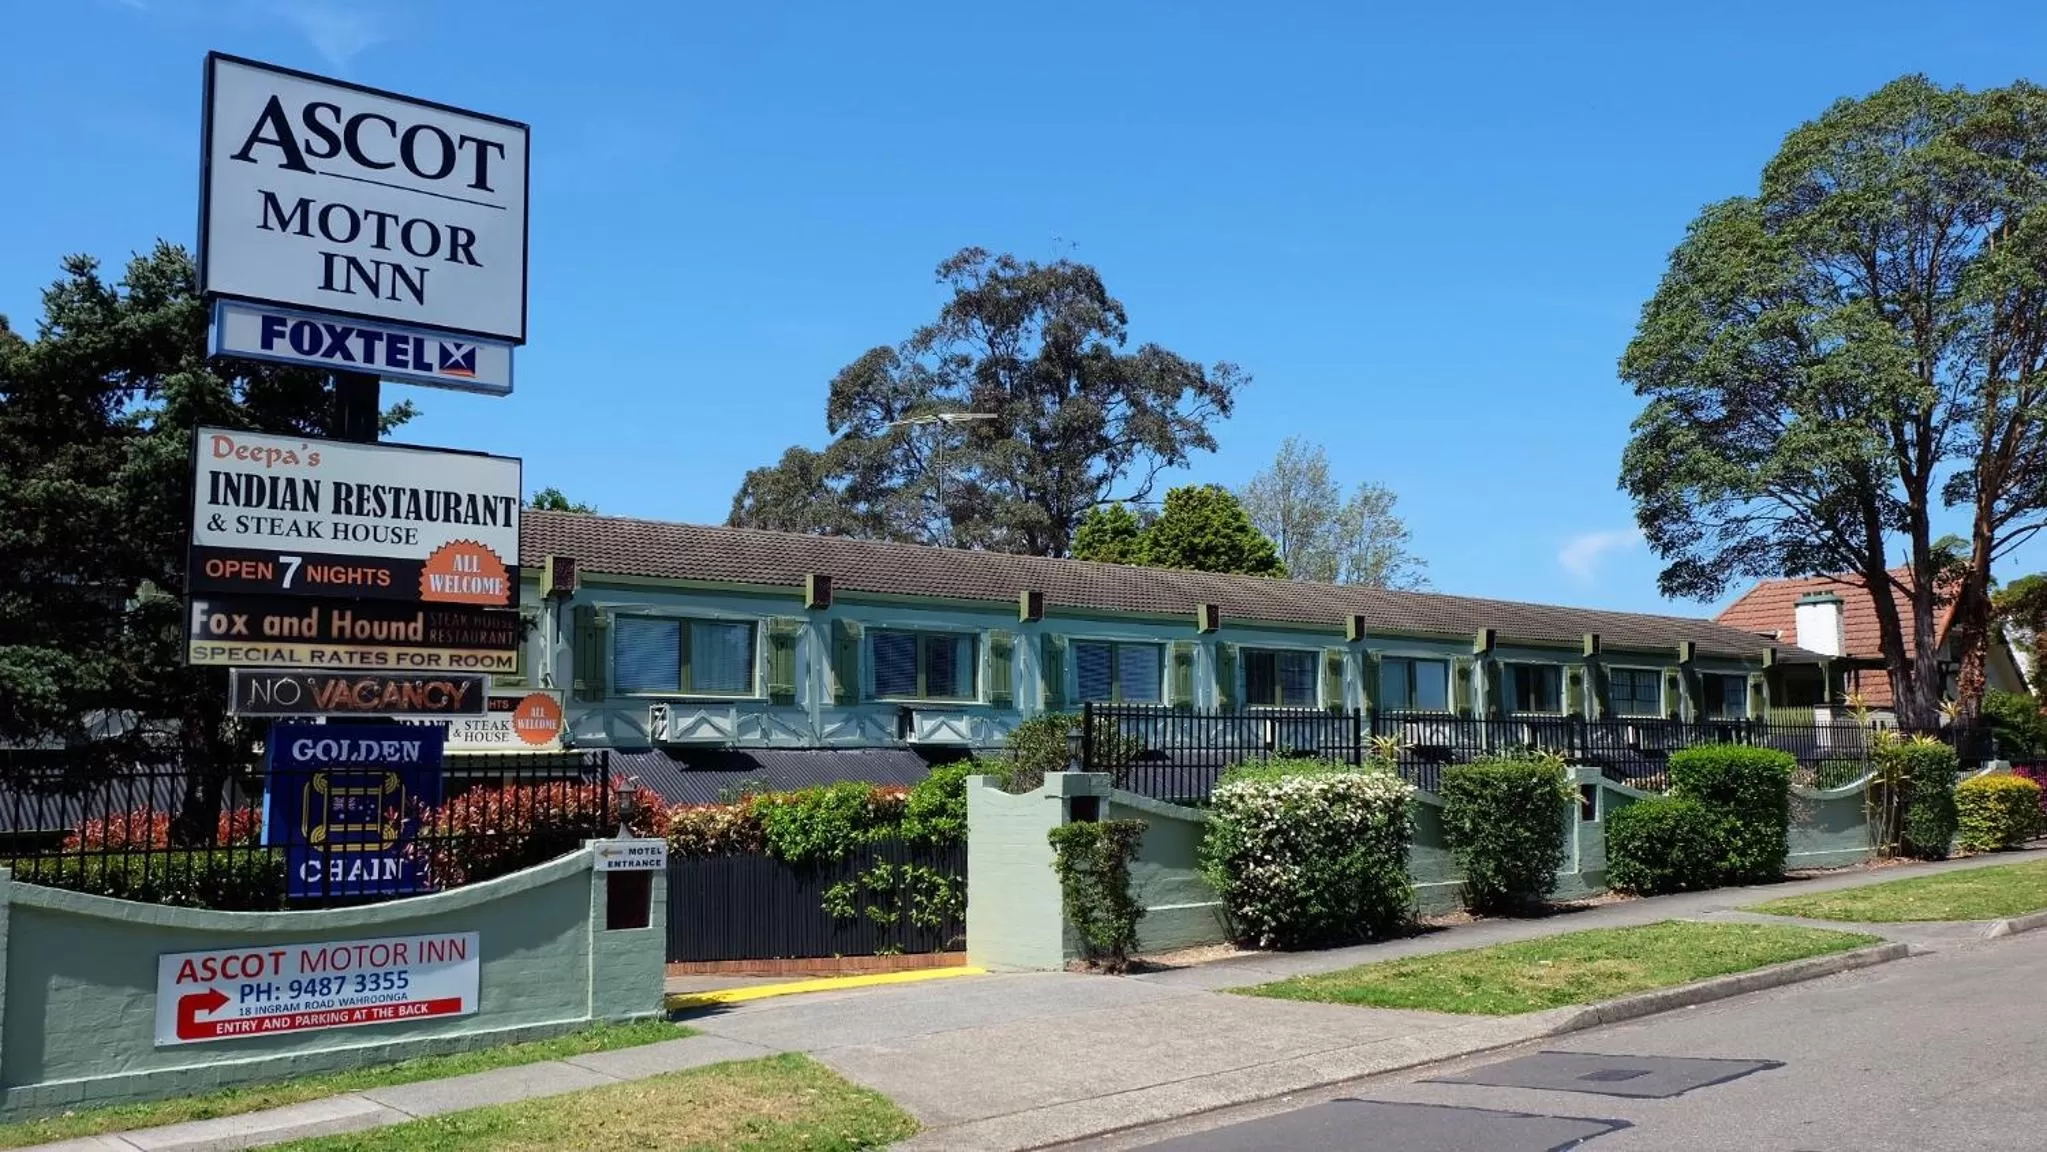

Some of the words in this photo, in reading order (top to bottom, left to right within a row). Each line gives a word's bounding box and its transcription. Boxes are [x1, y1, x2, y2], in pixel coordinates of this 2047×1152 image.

[230, 95, 505, 193] ASCOT
[257, 190, 483, 267] MOTOR
[318, 251, 430, 306] INN
[261, 315, 433, 372] FOXTEL
[211, 434, 321, 468] Deepa's
[207, 470, 321, 513] INDIAN
[331, 481, 516, 528] RESTAURANT
[207, 513, 227, 532] &
[235, 515, 323, 538] STEAK
[331, 522, 418, 545] HOUSE
[205, 559, 273, 579] OPEN
[279, 556, 302, 589] 7
[306, 565, 391, 586] NIGHTS
[453, 554, 480, 573] ALL
[429, 574, 503, 596] WELCOME
[191, 601, 249, 635] Fox
[263, 606, 319, 638] and
[331, 610, 423, 642] Hound
[429, 611, 469, 627] STEAK
[429, 628, 514, 645] RESTAURANT
[193, 646, 302, 662] SPECIAL
[310, 650, 388, 665] RATES
[396, 653, 440, 666] FOR
[449, 655, 512, 668] ROOM
[249, 677, 300, 707] NO
[309, 678, 470, 709] VACANCY
[488, 699, 510, 709] HTS
[517, 719, 557, 730] WELCOME
[531, 707, 544, 718] ALL
[453, 729, 462, 738] &
[464, 720, 510, 731] STEAK
[464, 732, 510, 743] HOUSE
[292, 739, 421, 762] GOLDEN
[608, 859, 661, 868] ENTRANCE
[628, 847, 662, 856] MOTEL
[300, 857, 404, 882] CHAIN
[176, 951, 286, 985] ASCOT
[301, 943, 408, 973] MOTOR
[419, 937, 466, 964] INN
[240, 983, 280, 1003] PH:
[289, 976, 346, 999] 9487
[354, 970, 409, 993] 3355
[239, 1006, 251, 1015] 18
[255, 1003, 300, 1015] INGRAM
[305, 999, 335, 1010] ROAD
[340, 992, 408, 1006] WAHROONGA
[216, 1021, 257, 1035] ENTRY
[262, 1017, 290, 1030] AND
[296, 1011, 349, 1026] PARKING
[353, 1009, 368, 1020] AT
[372, 1006, 395, 1018] THE
[399, 1004, 428, 1016] BACK
